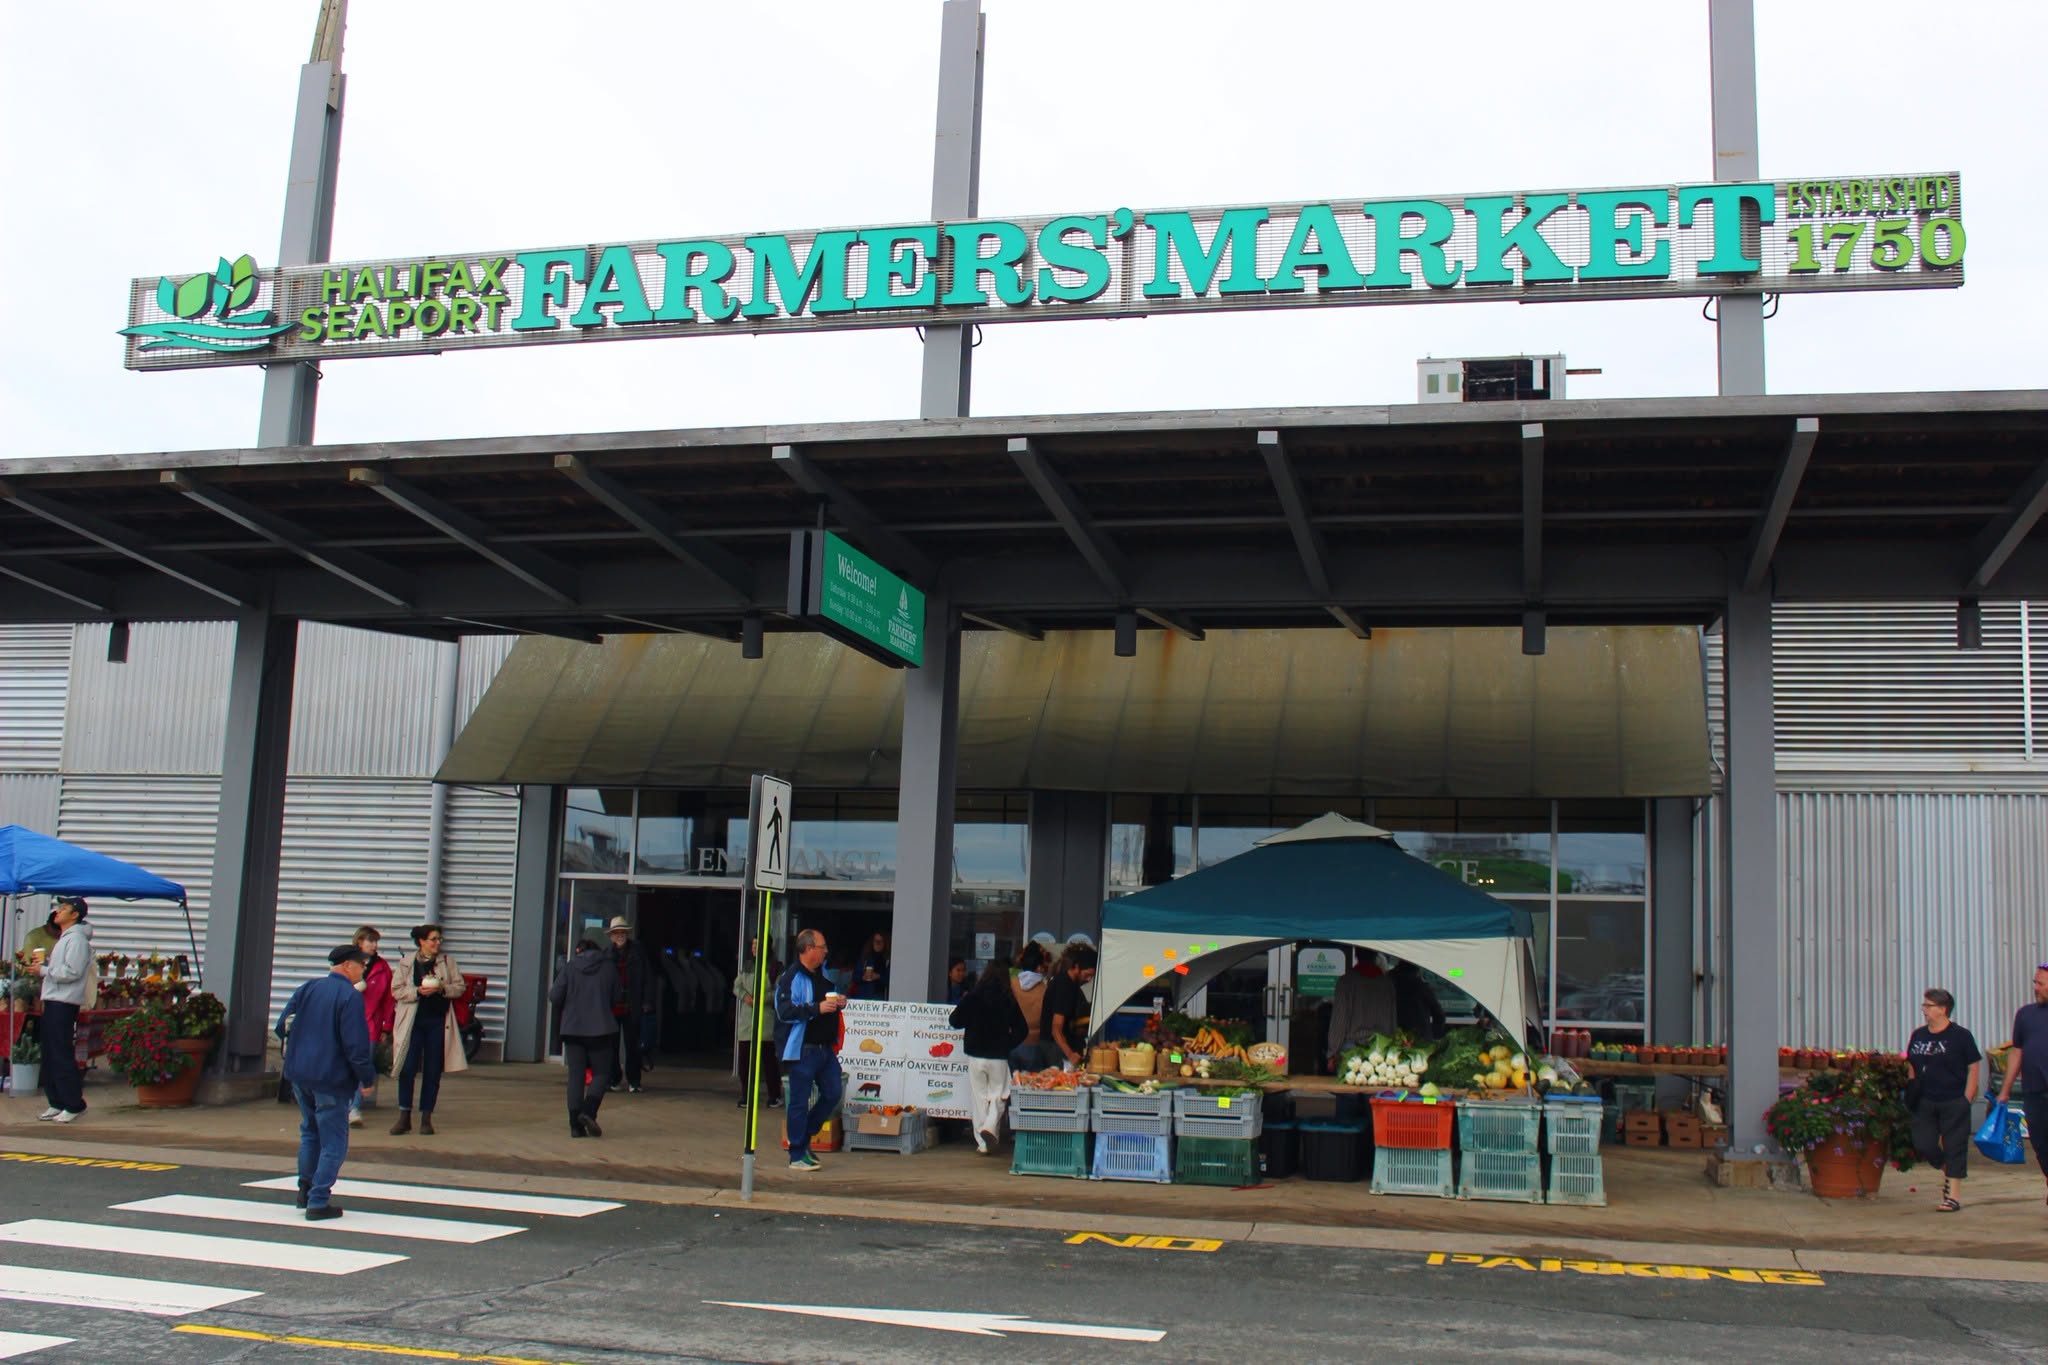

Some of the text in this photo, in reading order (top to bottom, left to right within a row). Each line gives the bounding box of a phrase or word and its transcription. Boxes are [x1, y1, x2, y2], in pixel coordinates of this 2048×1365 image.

[1786, 175, 1955, 218] ESTABLISHED
[512, 183, 1776, 331] FARMERS' MARKET
[1787, 216, 1967, 274] 1750
[320, 256, 507, 303] HALIFAX
[299, 292, 507, 342] SEAPORT
[838, 554, 878, 597] Welcome!
[698, 847, 881, 872] ENANCE
[846, 1003, 907, 1013] AKVIEW FARM
[910, 1004, 951, 1016] OAKVIEW
[880, 1059, 903, 1068] FARM
[907, 1061, 949, 1071] OAKVIEW
[856, 1073, 881, 1081] BEEF
[928, 1080, 953, 1089] EGGS
[928, 1108, 968, 1117] GSPORT
[1064, 1232, 1826, 1287] NO PARKING
